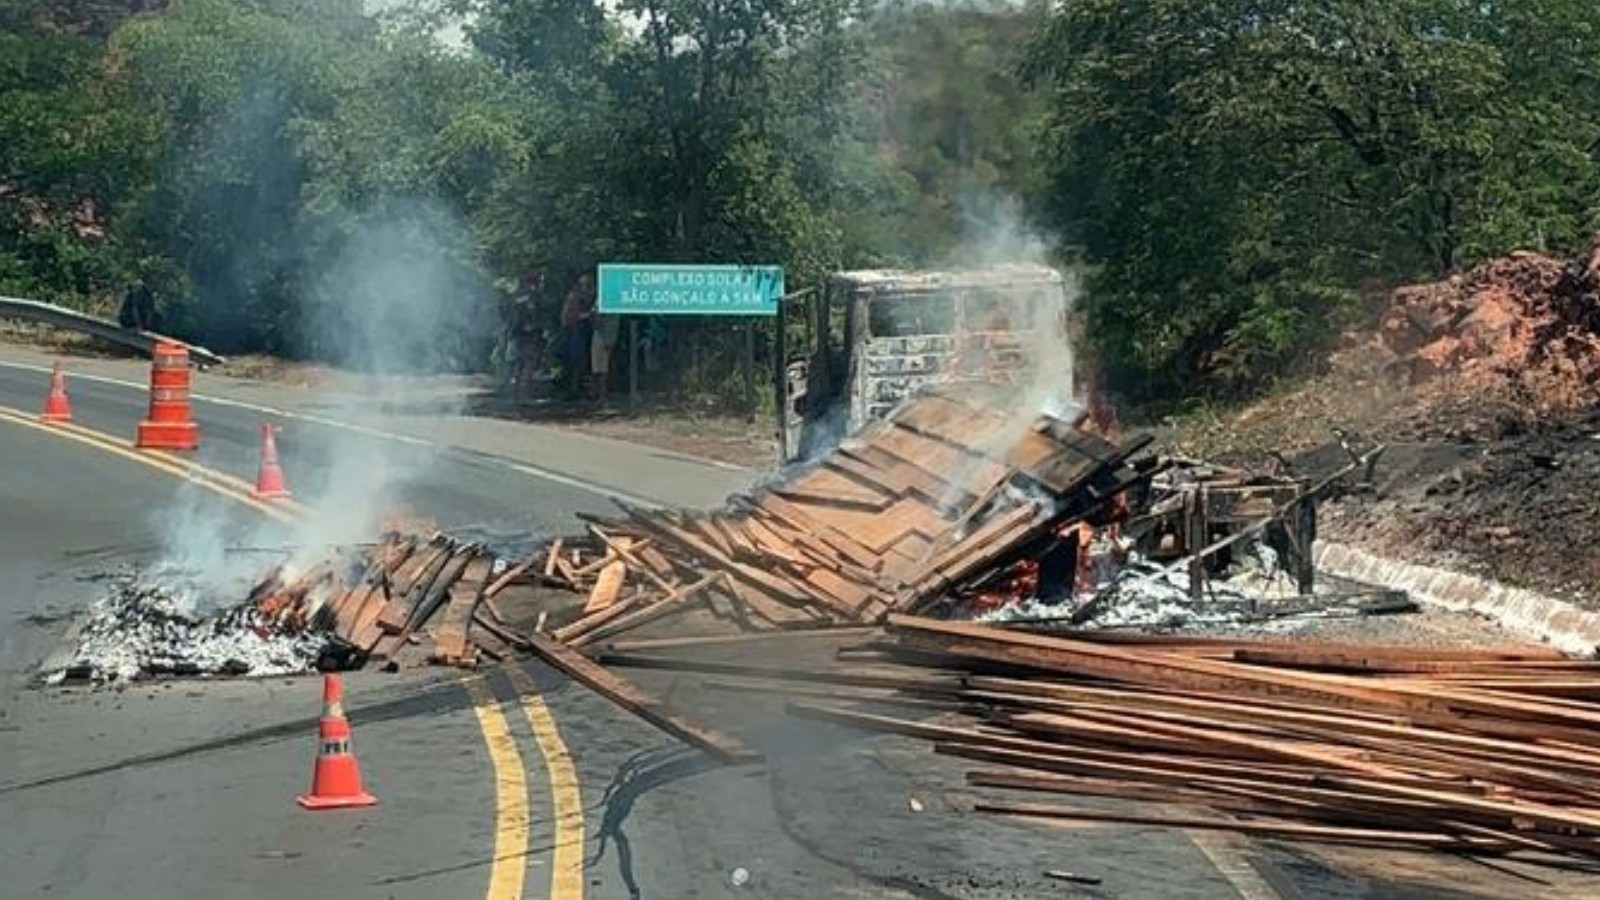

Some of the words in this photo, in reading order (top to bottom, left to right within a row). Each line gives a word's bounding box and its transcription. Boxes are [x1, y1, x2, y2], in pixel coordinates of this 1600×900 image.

[631, 271, 705, 287] COMPLEXO
[620, 286, 649, 304] SÃO
[653, 289, 718, 306] GONÇALO
